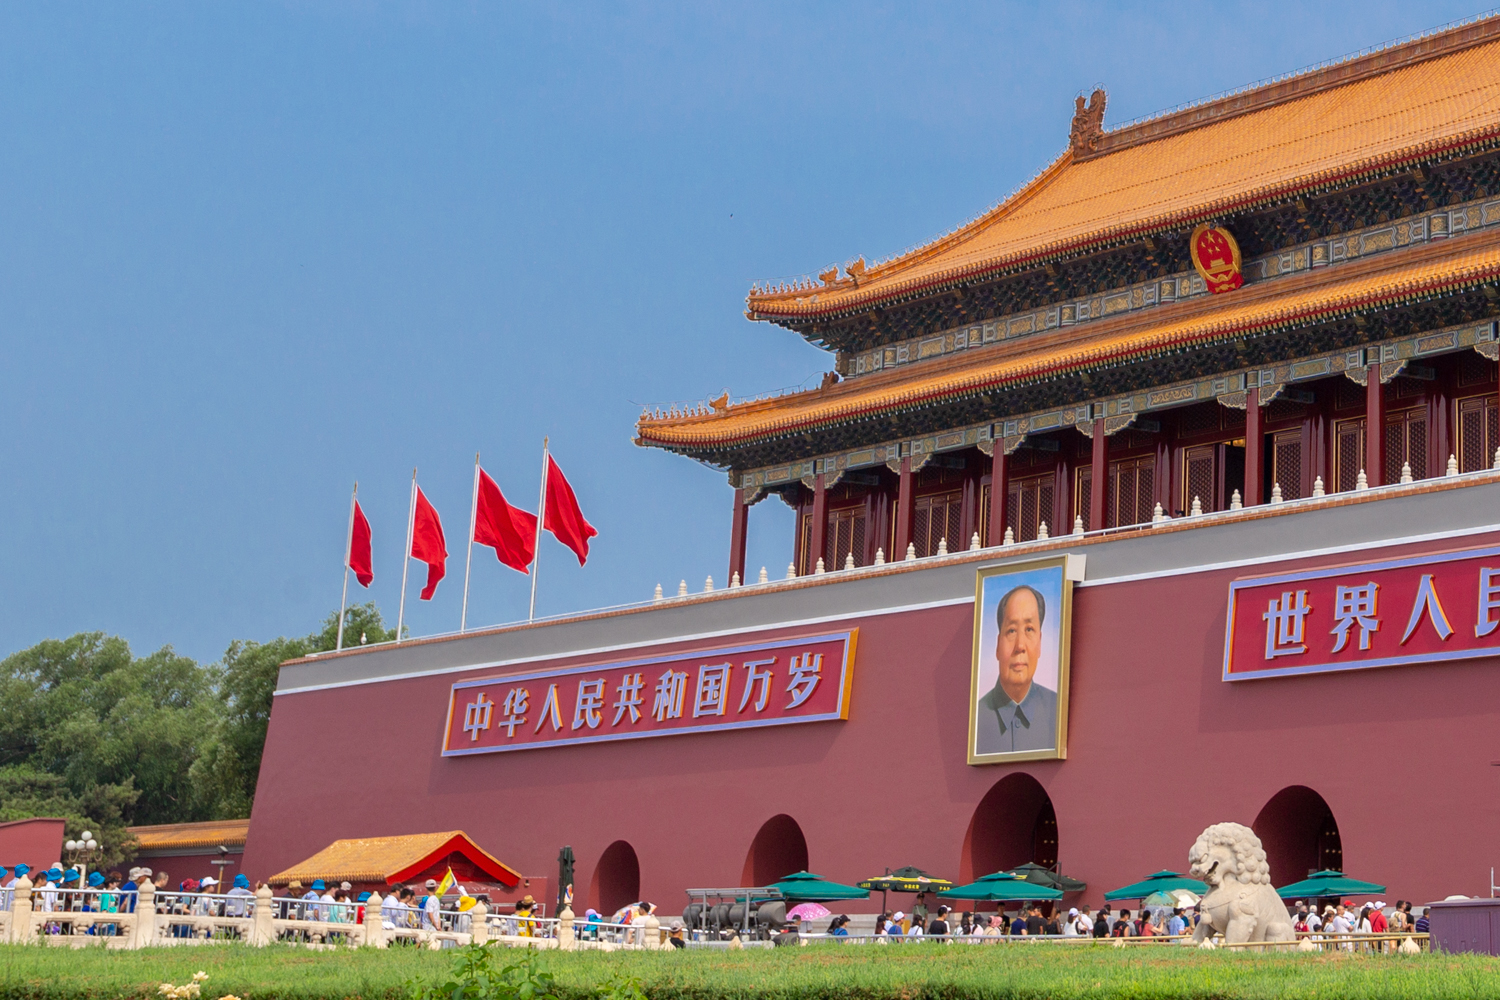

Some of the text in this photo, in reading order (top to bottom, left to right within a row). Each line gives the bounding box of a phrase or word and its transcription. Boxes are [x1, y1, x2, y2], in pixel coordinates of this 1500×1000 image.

[463, 652, 824, 742] 中华人民共和国万岁
